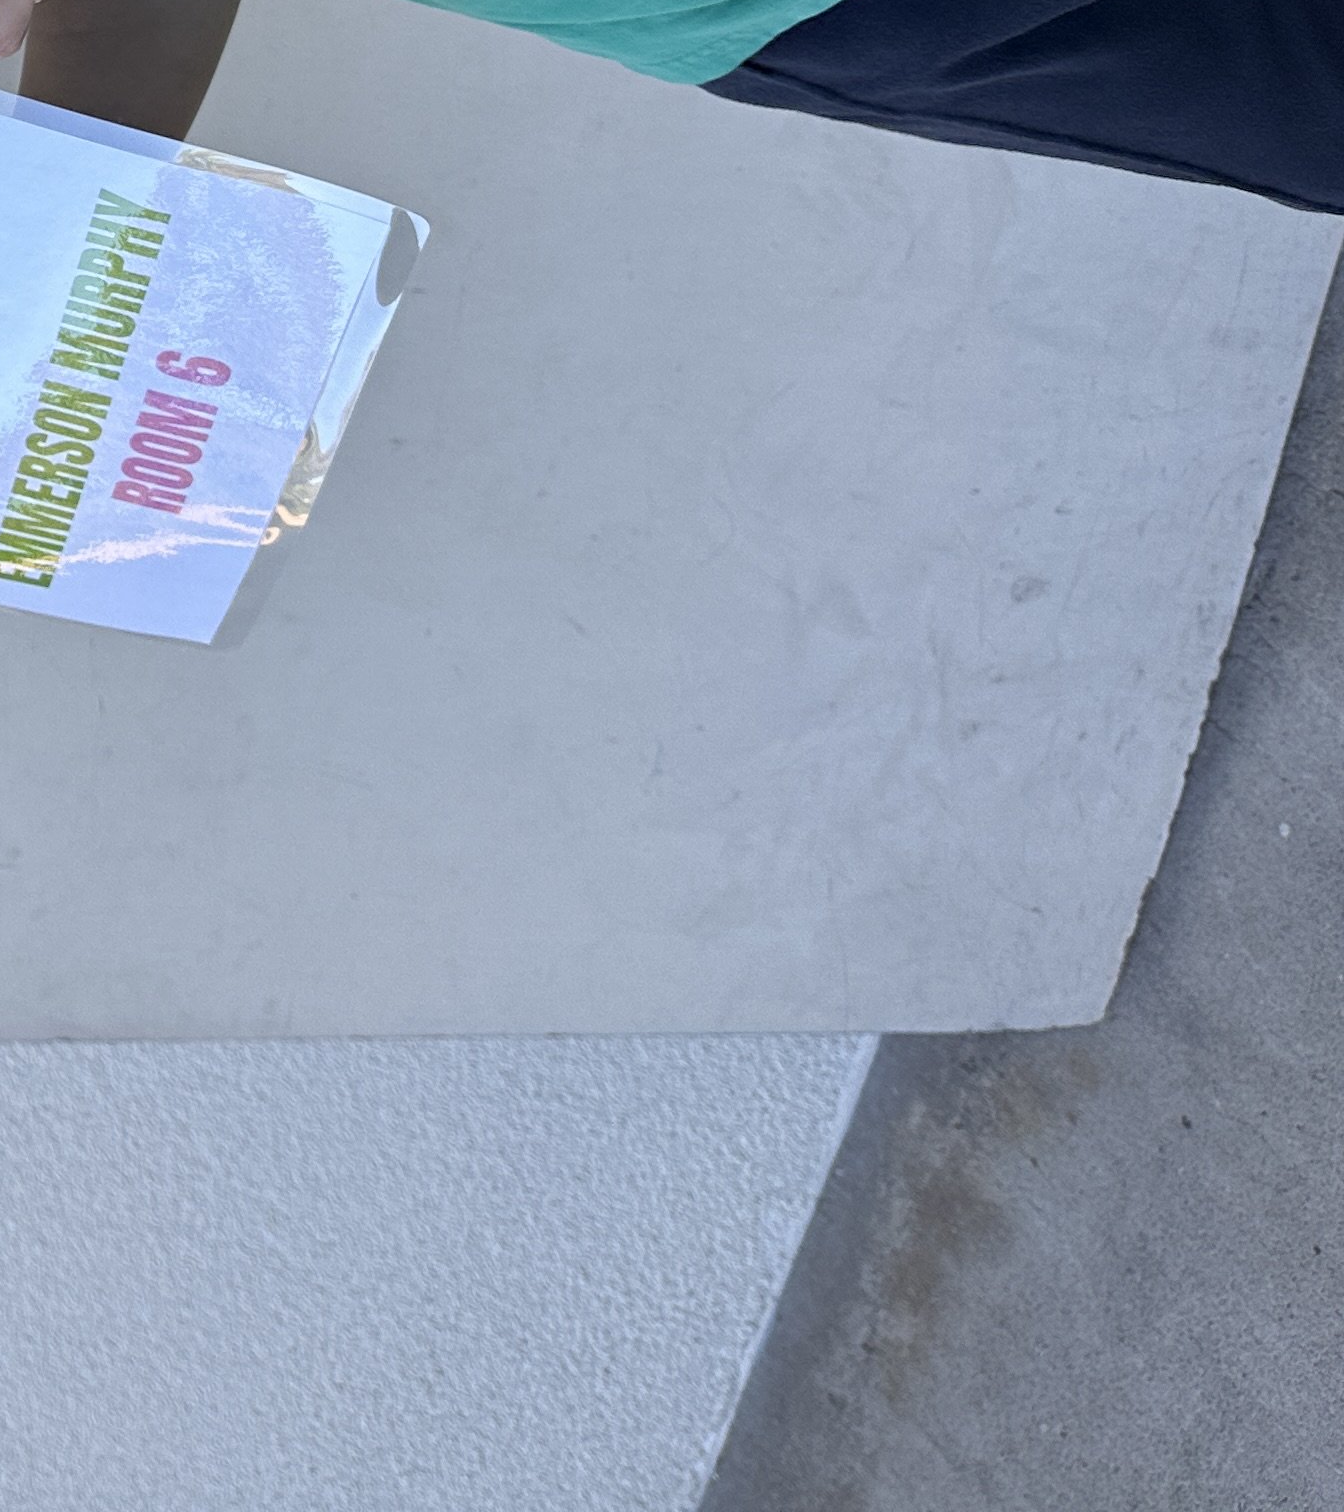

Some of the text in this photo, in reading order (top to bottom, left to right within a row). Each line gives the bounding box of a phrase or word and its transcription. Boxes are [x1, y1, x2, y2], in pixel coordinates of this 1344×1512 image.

[49, 188, 172, 382] MURPHY
[112, 349, 232, 515] ROOM 6
